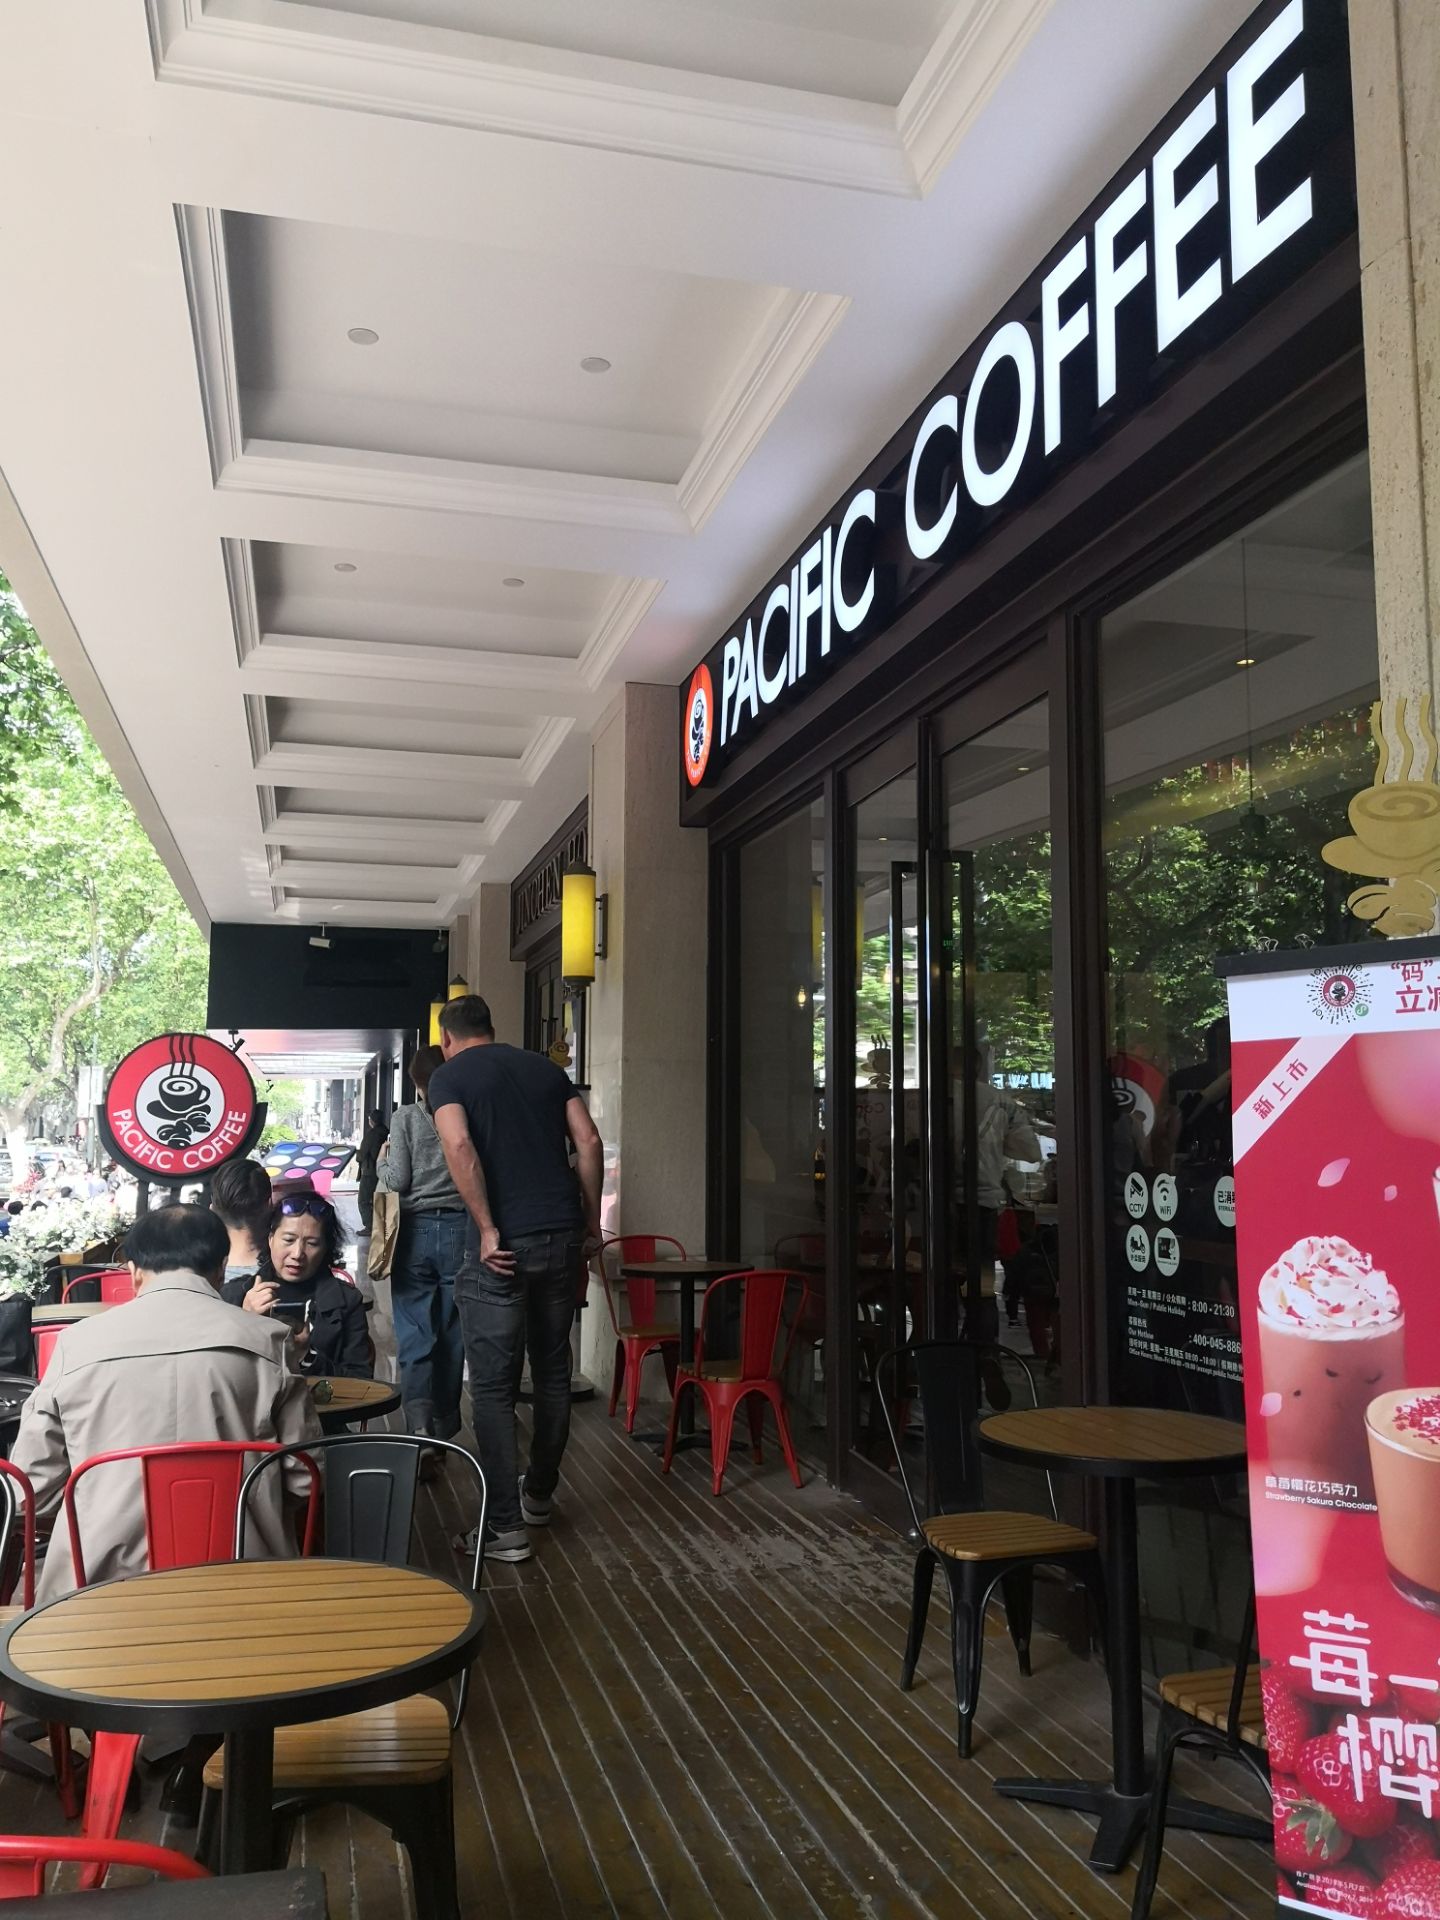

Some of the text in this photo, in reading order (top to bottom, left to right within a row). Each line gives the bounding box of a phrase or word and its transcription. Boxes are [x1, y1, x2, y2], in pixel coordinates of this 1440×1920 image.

[720, 0, 1313, 747] PACIFIC COFFEE
[1391, 959, 1440, 982] “码”
[1252, 1057, 1309, 1120] 新上市
[112, 1108, 247, 1169] PACIFIC COFFEE
[1129, 1203, 1144, 1213] CCTV
[1160, 1206, 1171, 1215] WiFi
[1213, 1304, 1235, 1318] 21:30
[1264, 1490, 1378, 1512] Strawberry Sakura Chocolate
[1289, 1609, 1440, 1708] 莓一
